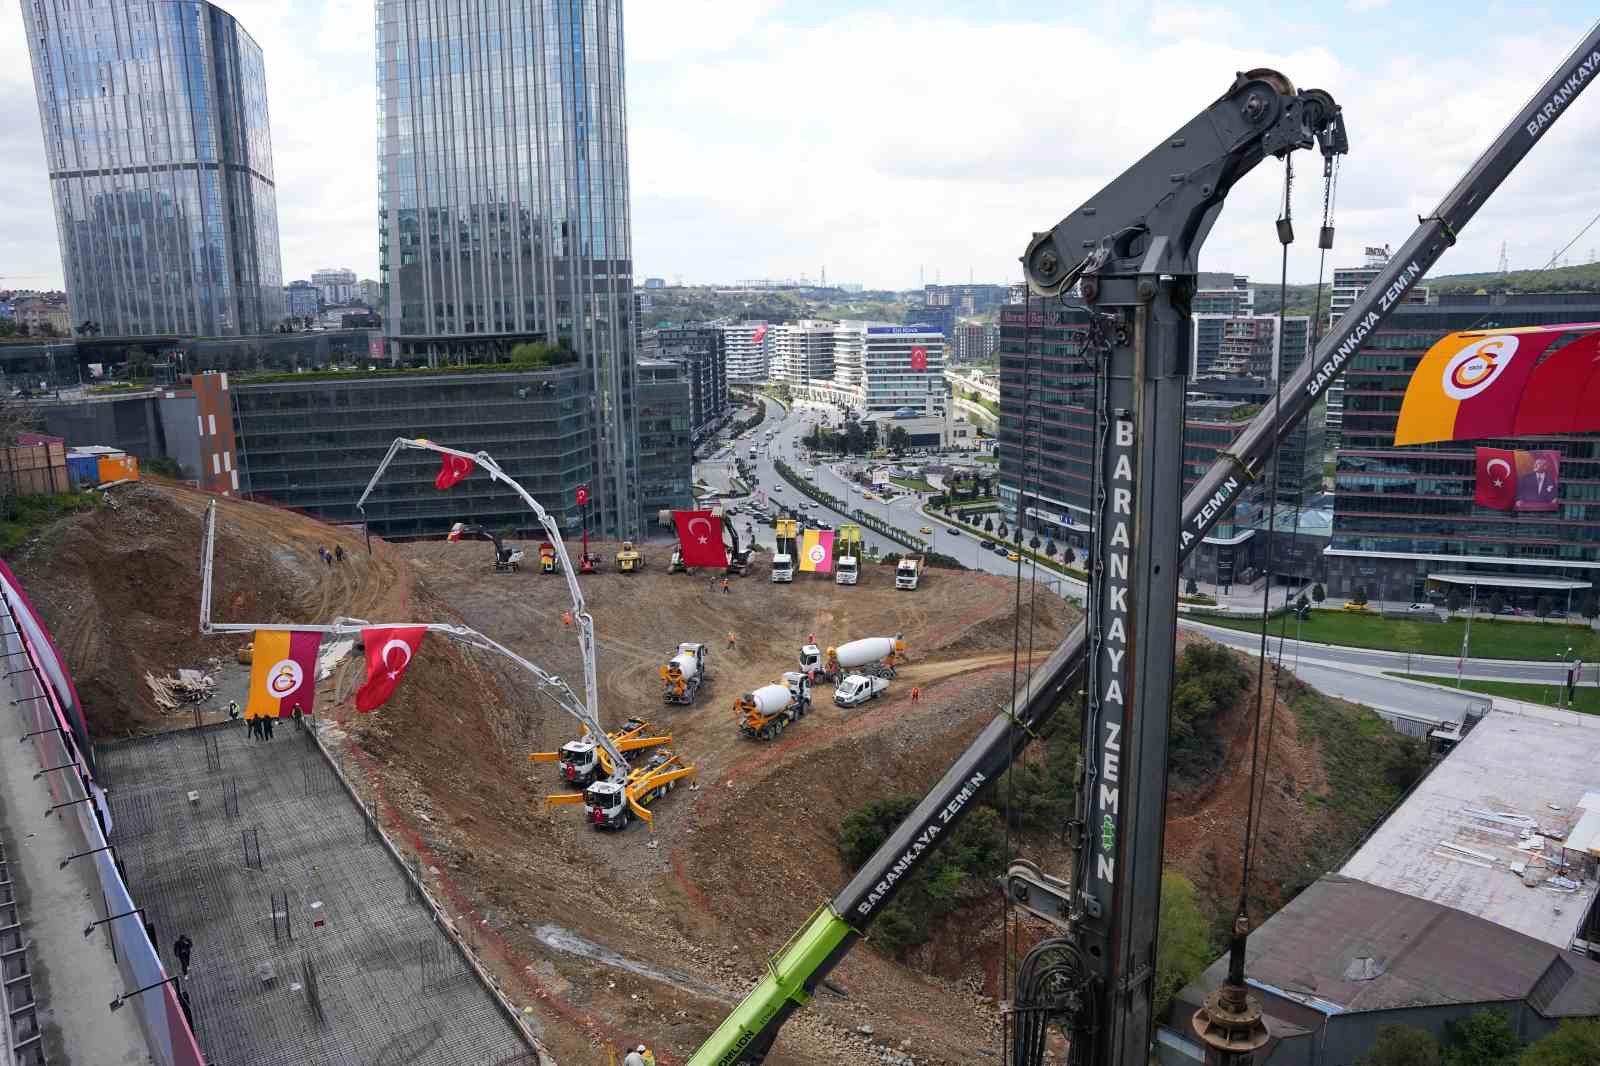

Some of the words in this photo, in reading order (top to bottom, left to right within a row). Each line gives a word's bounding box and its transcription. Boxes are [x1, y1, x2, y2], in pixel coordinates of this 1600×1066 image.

[1527, 51, 1600, 136] BARANKAYA
[1306, 311, 1380, 396] BARANKAYA
[1105, 420, 1134, 705] BARANKAYA
[857, 824, 942, 915] BARANKAYA
